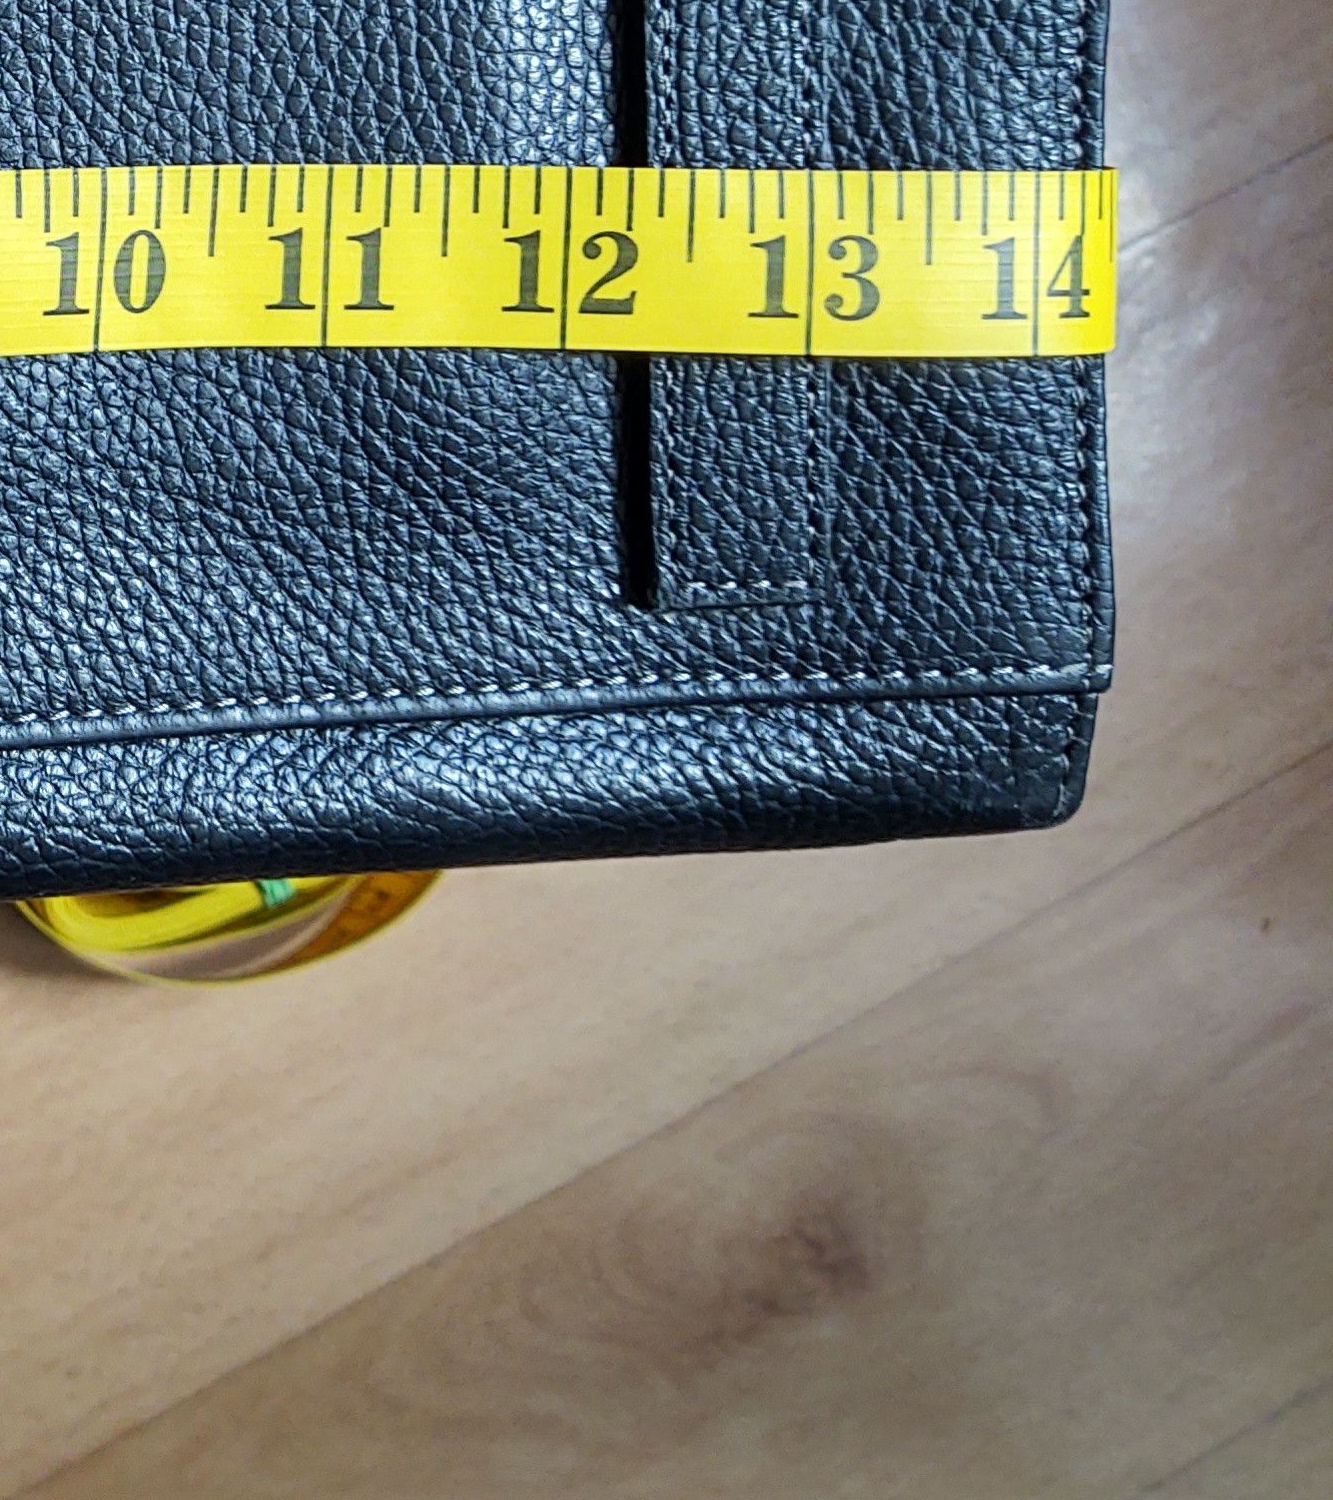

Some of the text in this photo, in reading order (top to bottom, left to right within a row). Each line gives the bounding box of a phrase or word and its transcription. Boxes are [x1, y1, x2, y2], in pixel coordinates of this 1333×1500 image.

[42, 229, 167, 316] 10
[265, 227, 395, 311] 11
[501, 230, 640, 315] 12
[747, 234, 881, 322] 13
[981, 235, 1091, 321] 14
